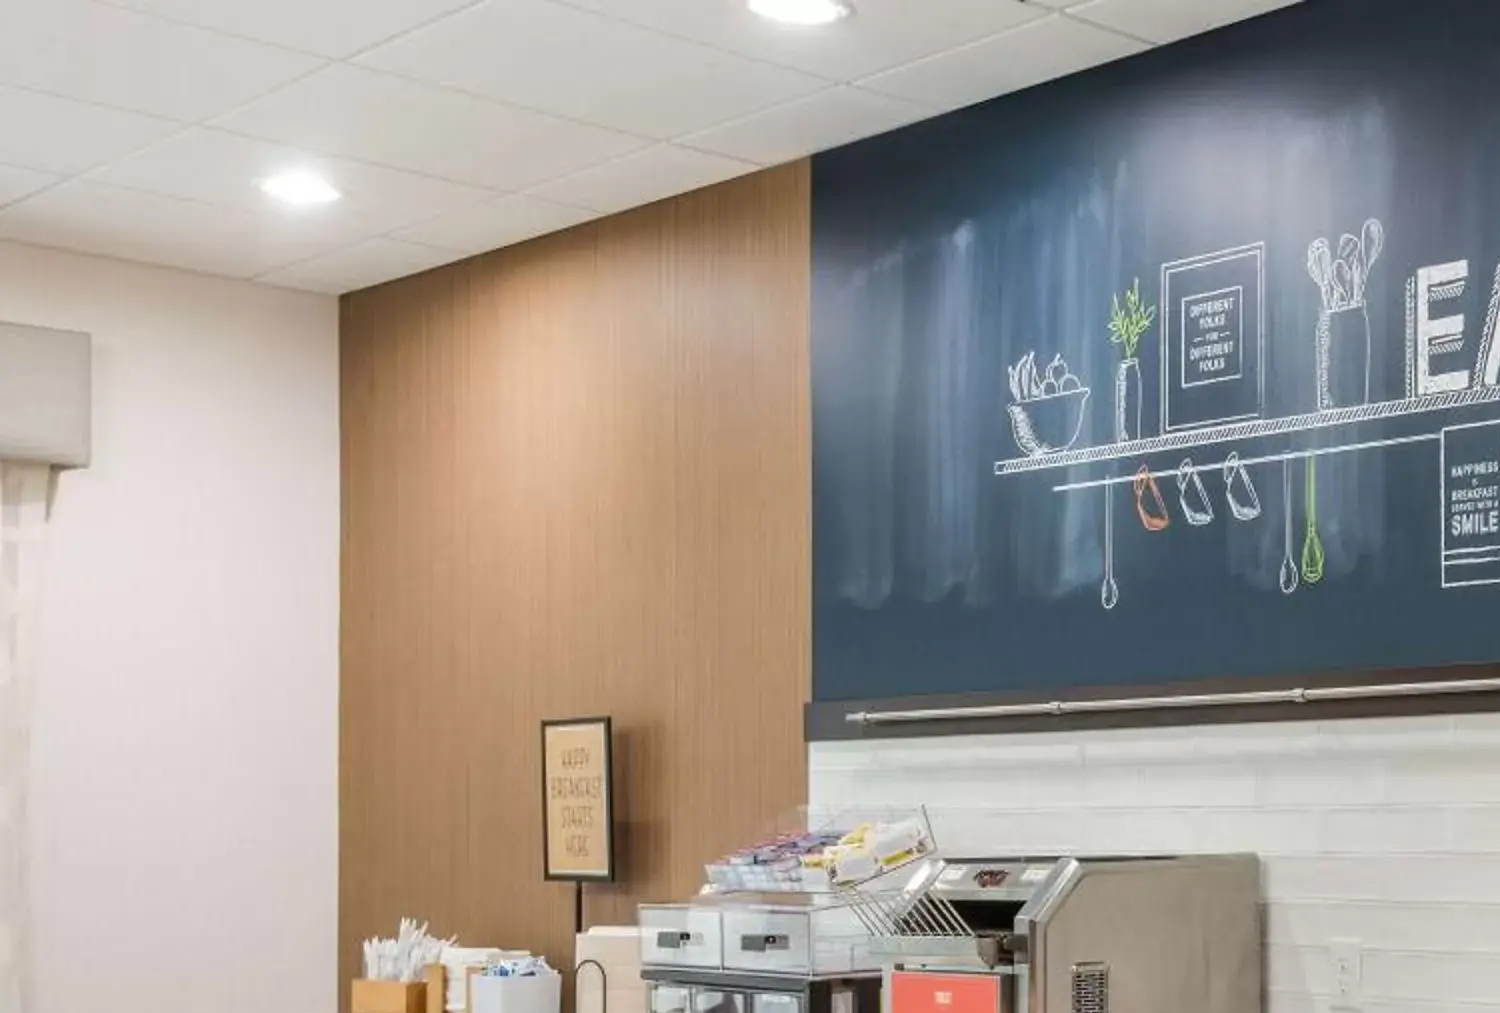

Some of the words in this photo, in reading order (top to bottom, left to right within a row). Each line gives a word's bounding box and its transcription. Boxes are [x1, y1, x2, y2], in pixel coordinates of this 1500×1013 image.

[1188, 297, 1235, 318] DIFFERENT
[1188, 340, 1234, 361] DIFFERENT
[1199, 357, 1225, 372] FOLKS
[1451, 461, 1499, 478] HAPPINESS
[1451, 485, 1499, 501] BREAKFAST
[1451, 510, 1499, 537] SMILE
